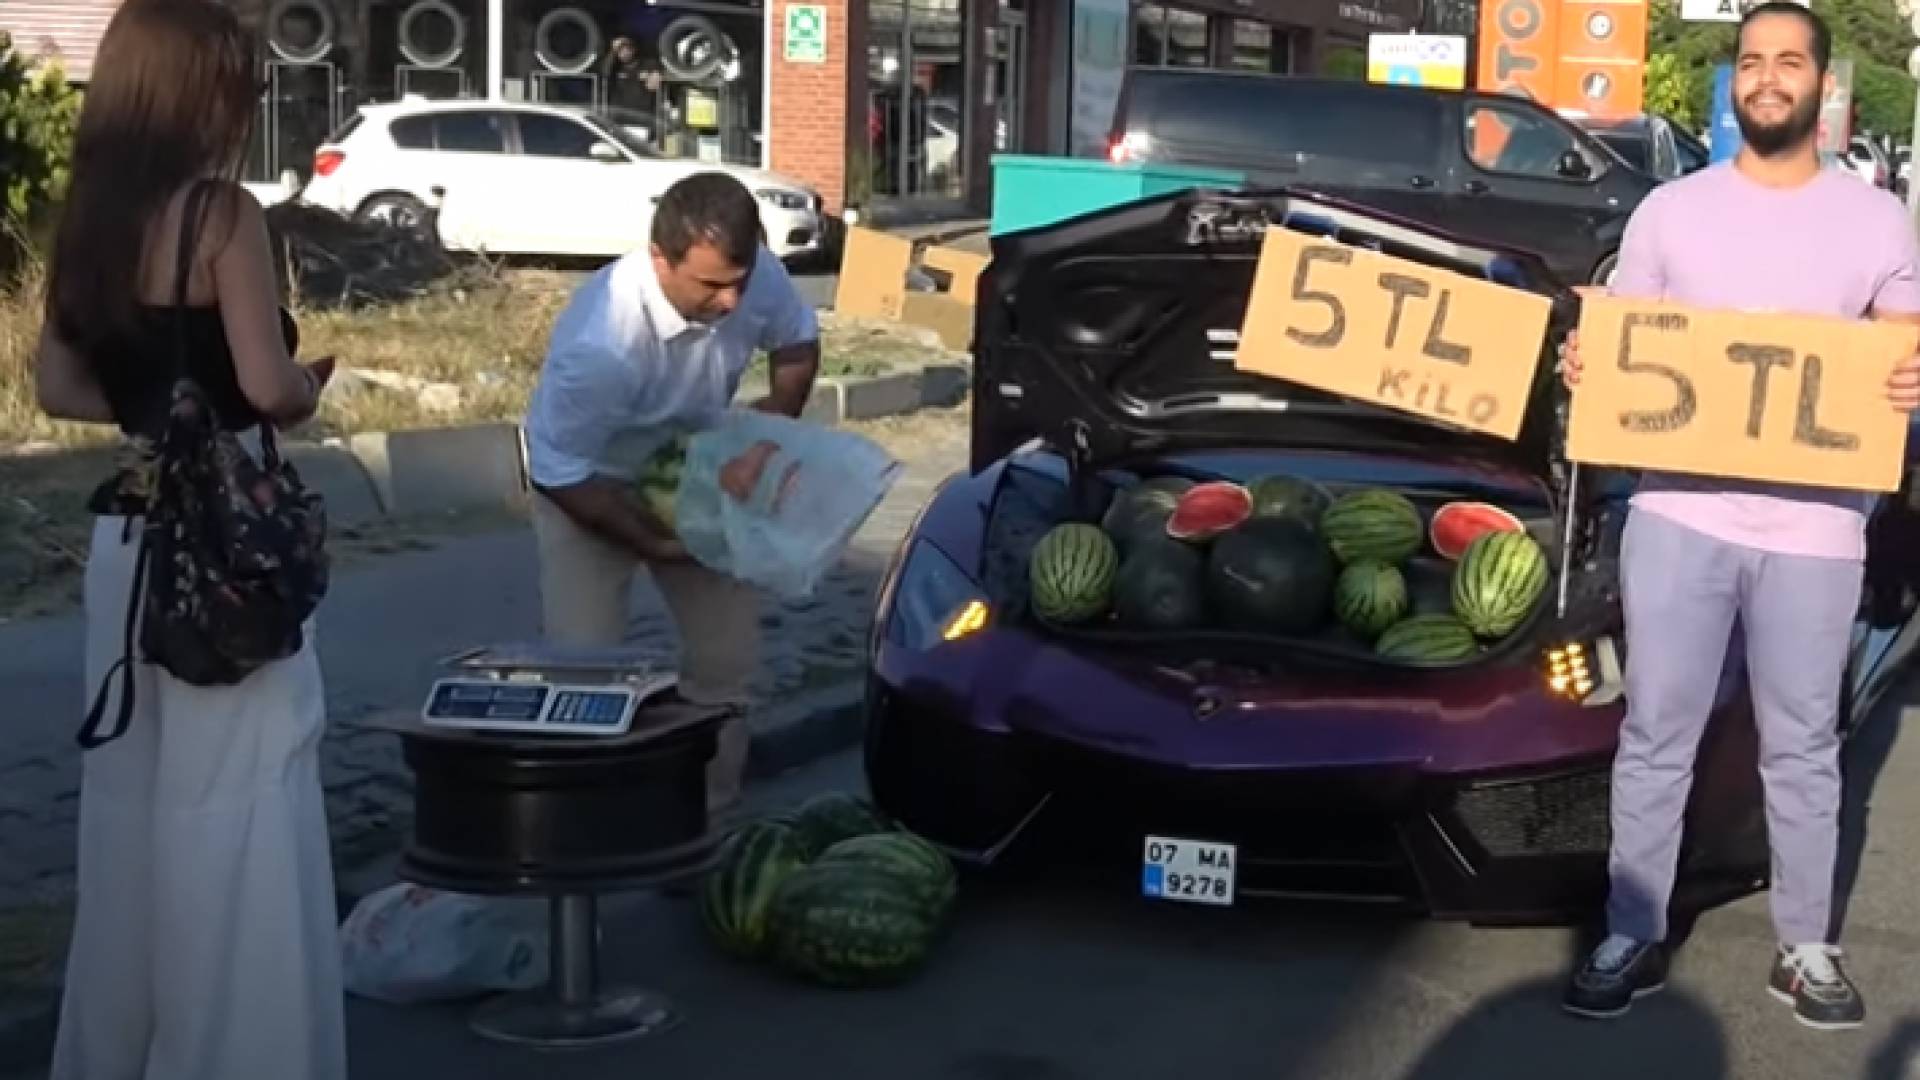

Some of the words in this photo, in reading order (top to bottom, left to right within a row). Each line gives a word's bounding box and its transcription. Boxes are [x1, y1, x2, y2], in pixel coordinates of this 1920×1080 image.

[1285, 246, 1353, 349] 5
[1377, 272, 1472, 367] TL
[1617, 312, 1697, 433] 5
[1726, 341, 1861, 451] TL
[1150, 843, 1178, 863] 07
[1198, 848, 1229, 869] MA
[1168, 873, 1227, 896] 9278
